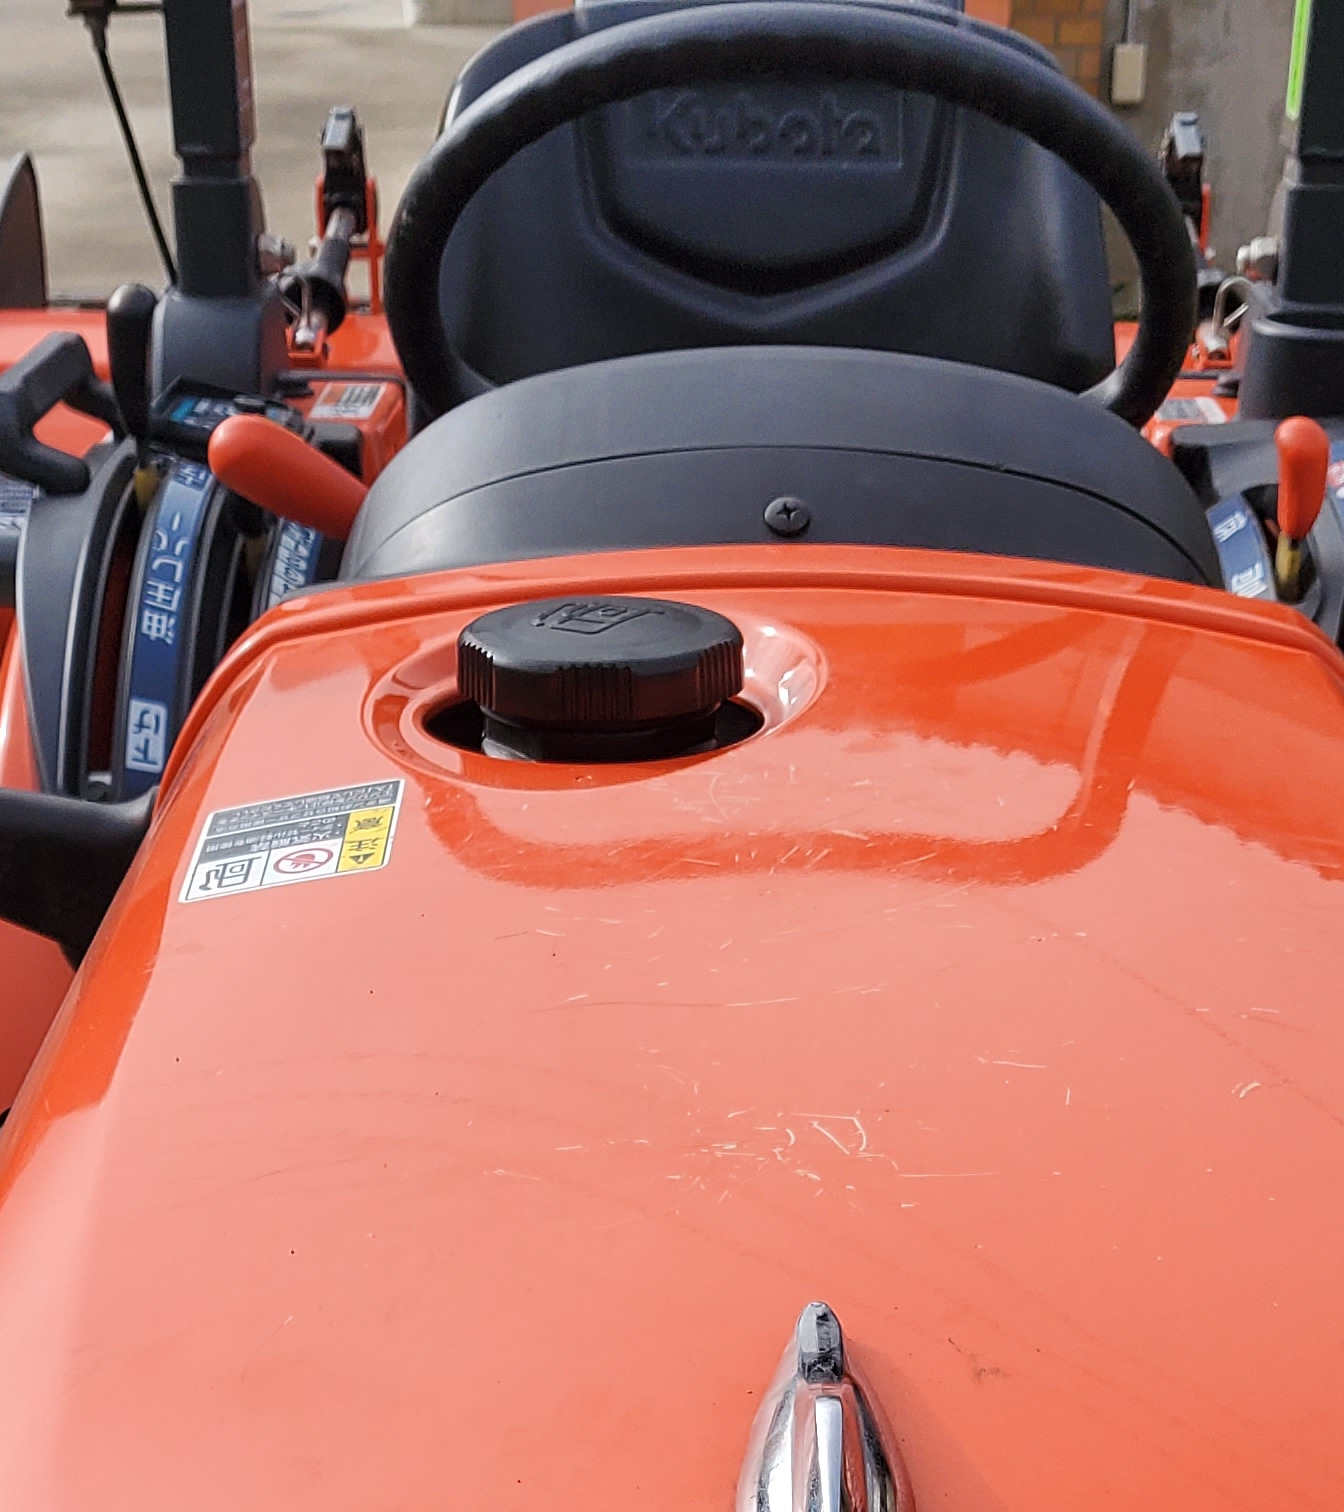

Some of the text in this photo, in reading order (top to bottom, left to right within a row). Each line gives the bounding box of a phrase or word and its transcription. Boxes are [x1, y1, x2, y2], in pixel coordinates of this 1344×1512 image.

[650, 92, 882, 156] Kubota
[141, 511, 190, 644] 油圧レバー
[131, 709, 160, 765] 下げ
[348, 815, 384, 852] 注意
